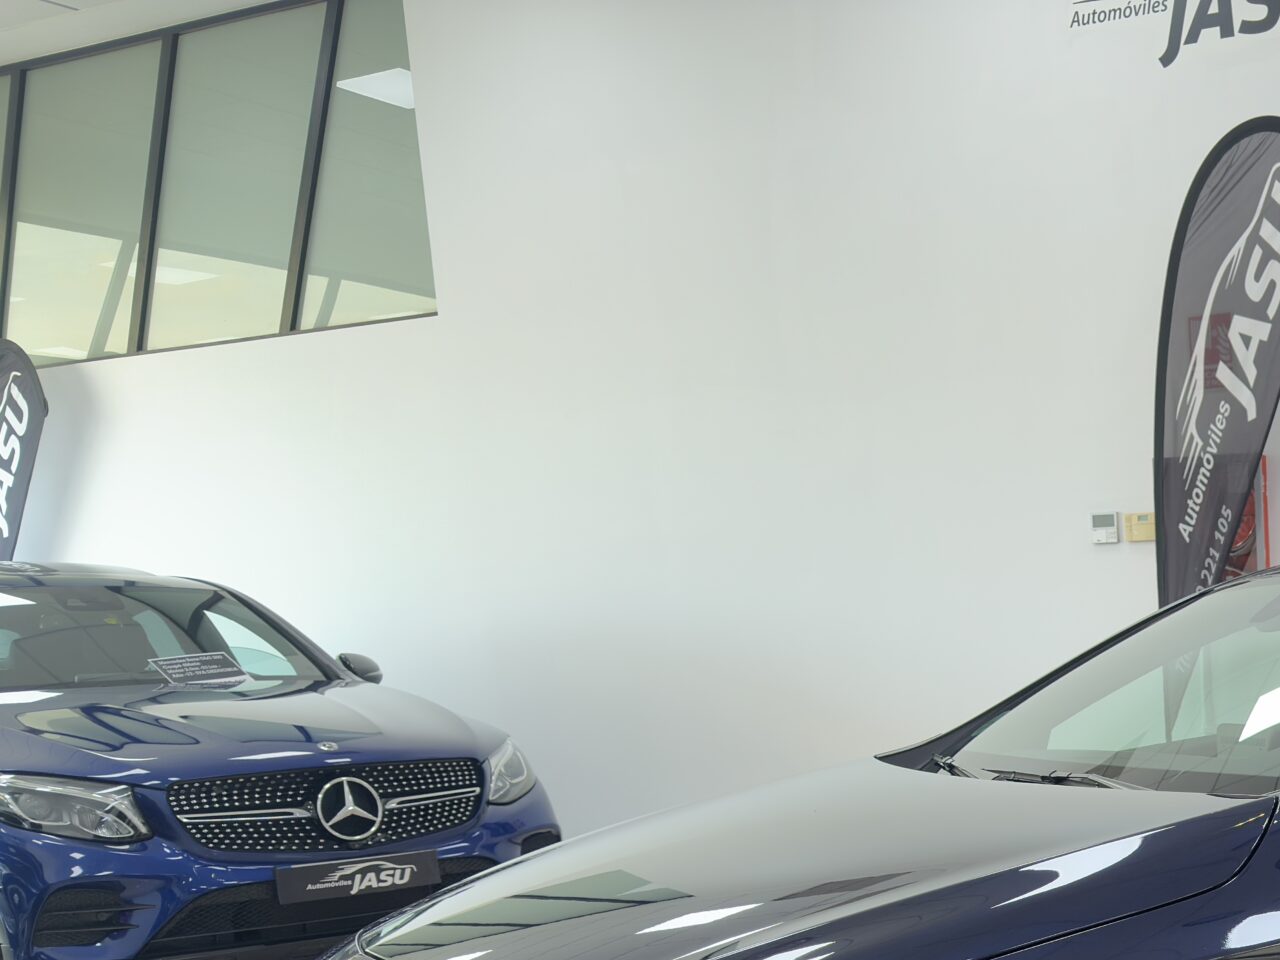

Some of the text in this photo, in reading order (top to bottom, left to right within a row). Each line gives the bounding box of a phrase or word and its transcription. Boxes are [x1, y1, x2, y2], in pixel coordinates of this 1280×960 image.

[1070, 0, 1167, 28] Automóviles
[1178, 401, 1231, 543] Automóviles
[1201, 505, 1232, 586] 221 105
[306, 868, 411, 895] Automóviles JASU
